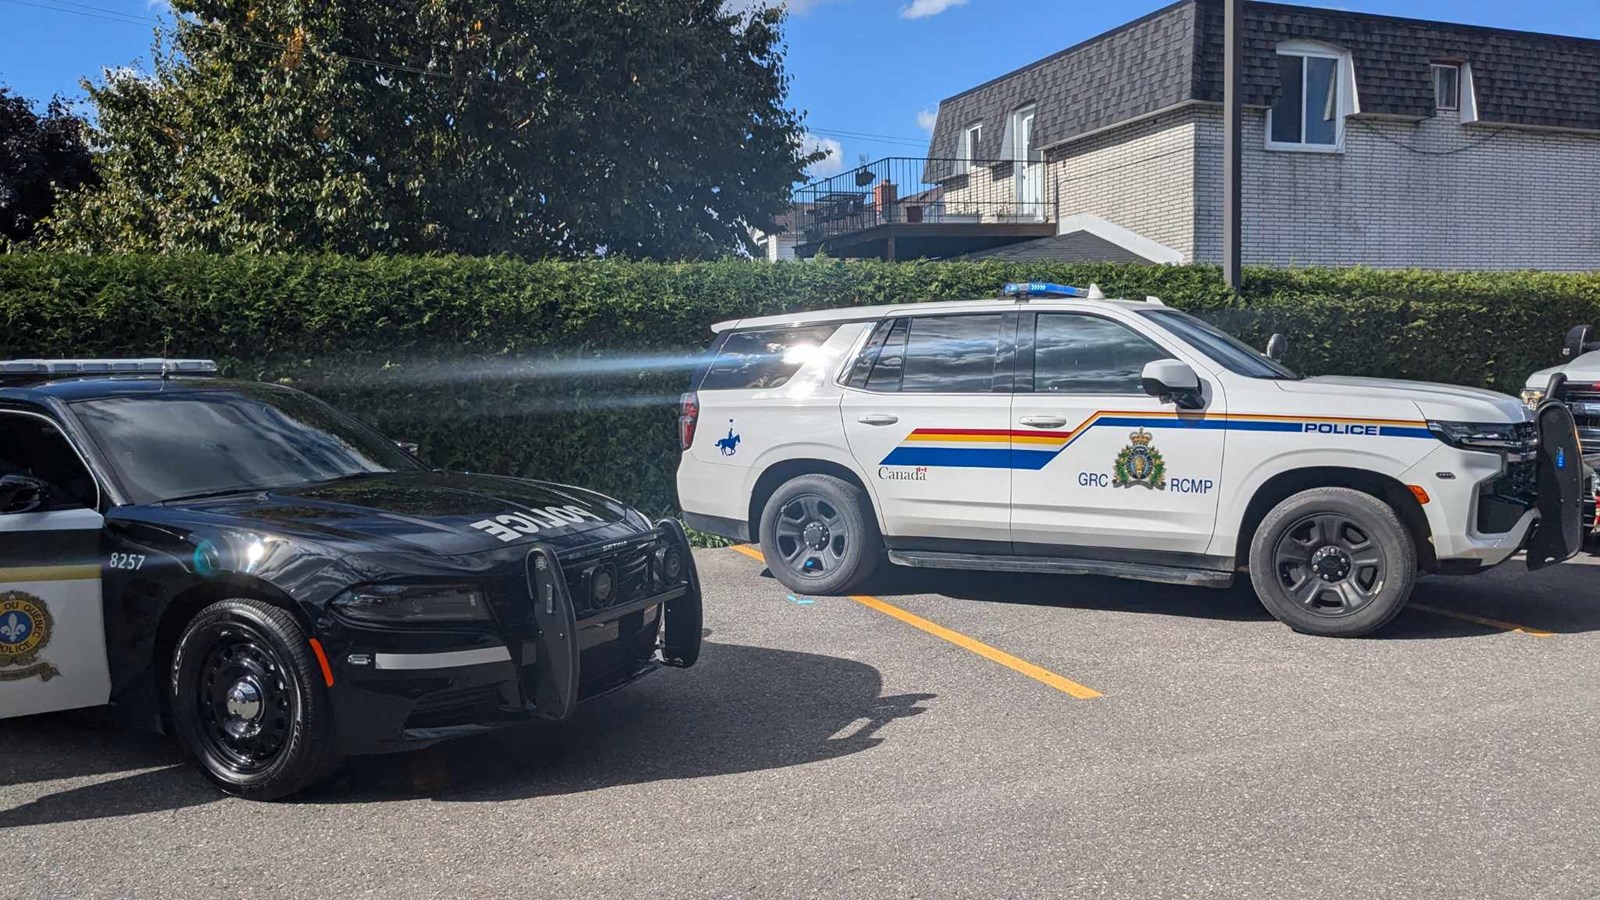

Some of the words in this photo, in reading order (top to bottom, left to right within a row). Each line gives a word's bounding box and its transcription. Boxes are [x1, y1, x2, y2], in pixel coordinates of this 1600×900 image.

[1304, 423, 1378, 436] POLICE
[878, 466, 927, 481] Canada
[1078, 472, 1109, 488] GRC
[1170, 478, 1213, 494] RCMP
[109, 552, 146, 571] 8257
[5, 601, 19, 610] DU
[0, 641, 33, 654] OLICE
